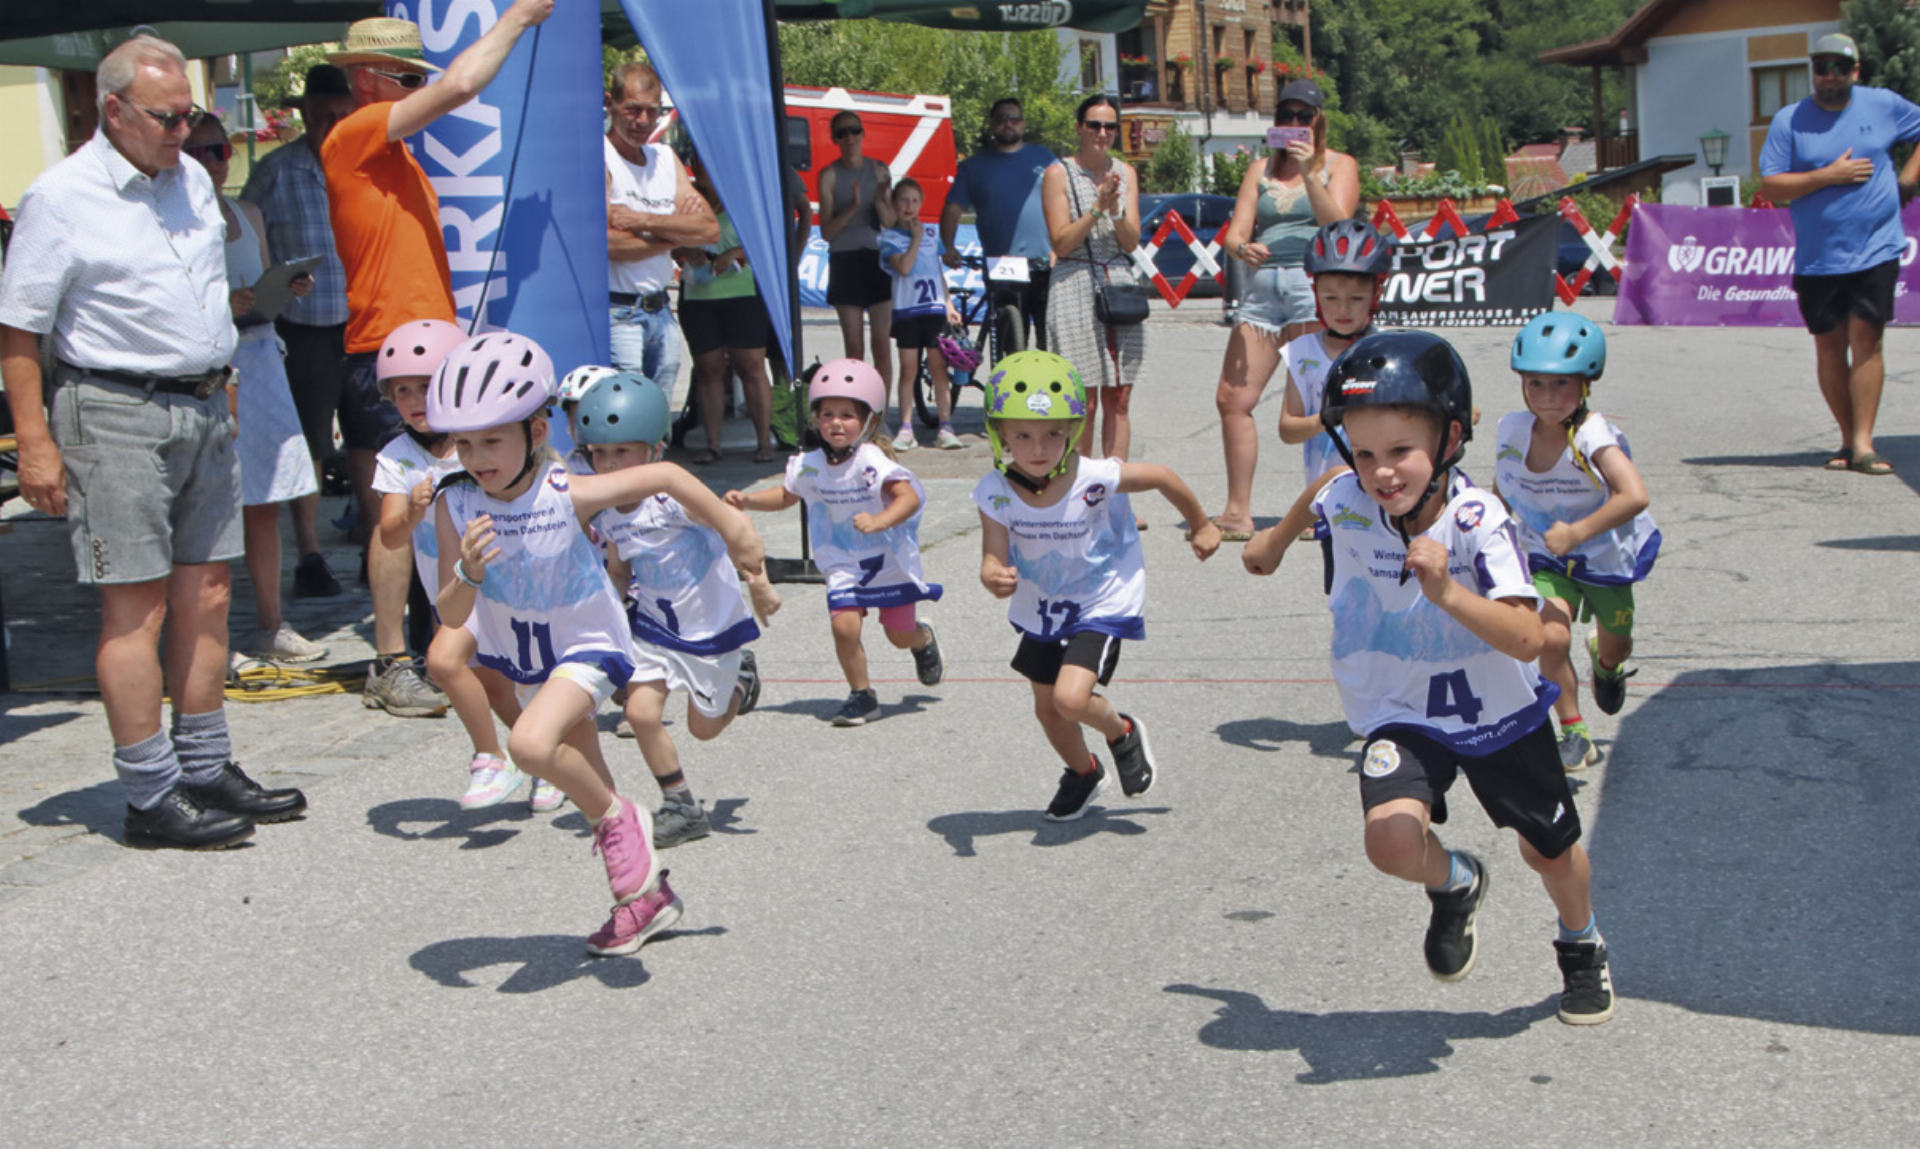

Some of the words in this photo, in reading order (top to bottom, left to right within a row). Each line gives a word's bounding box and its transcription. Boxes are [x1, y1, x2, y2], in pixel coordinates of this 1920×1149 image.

[999, 266, 1016, 276] 21
[1705, 246, 1796, 276] GRAW
[914, 280, 937, 304] 21
[1379, 267, 1487, 303] NER
[1697, 285, 1720, 301] Die
[1372, 308, 1513, 321] AMSAUERSTRASSE
[503, 527, 519, 537] am
[520, 520, 568, 536] Dachstein
[1039, 531, 1051, 540] am
[859, 553, 885, 587] 7
[511, 616, 557, 671] 11
[1426, 668, 1483, 724] 4
